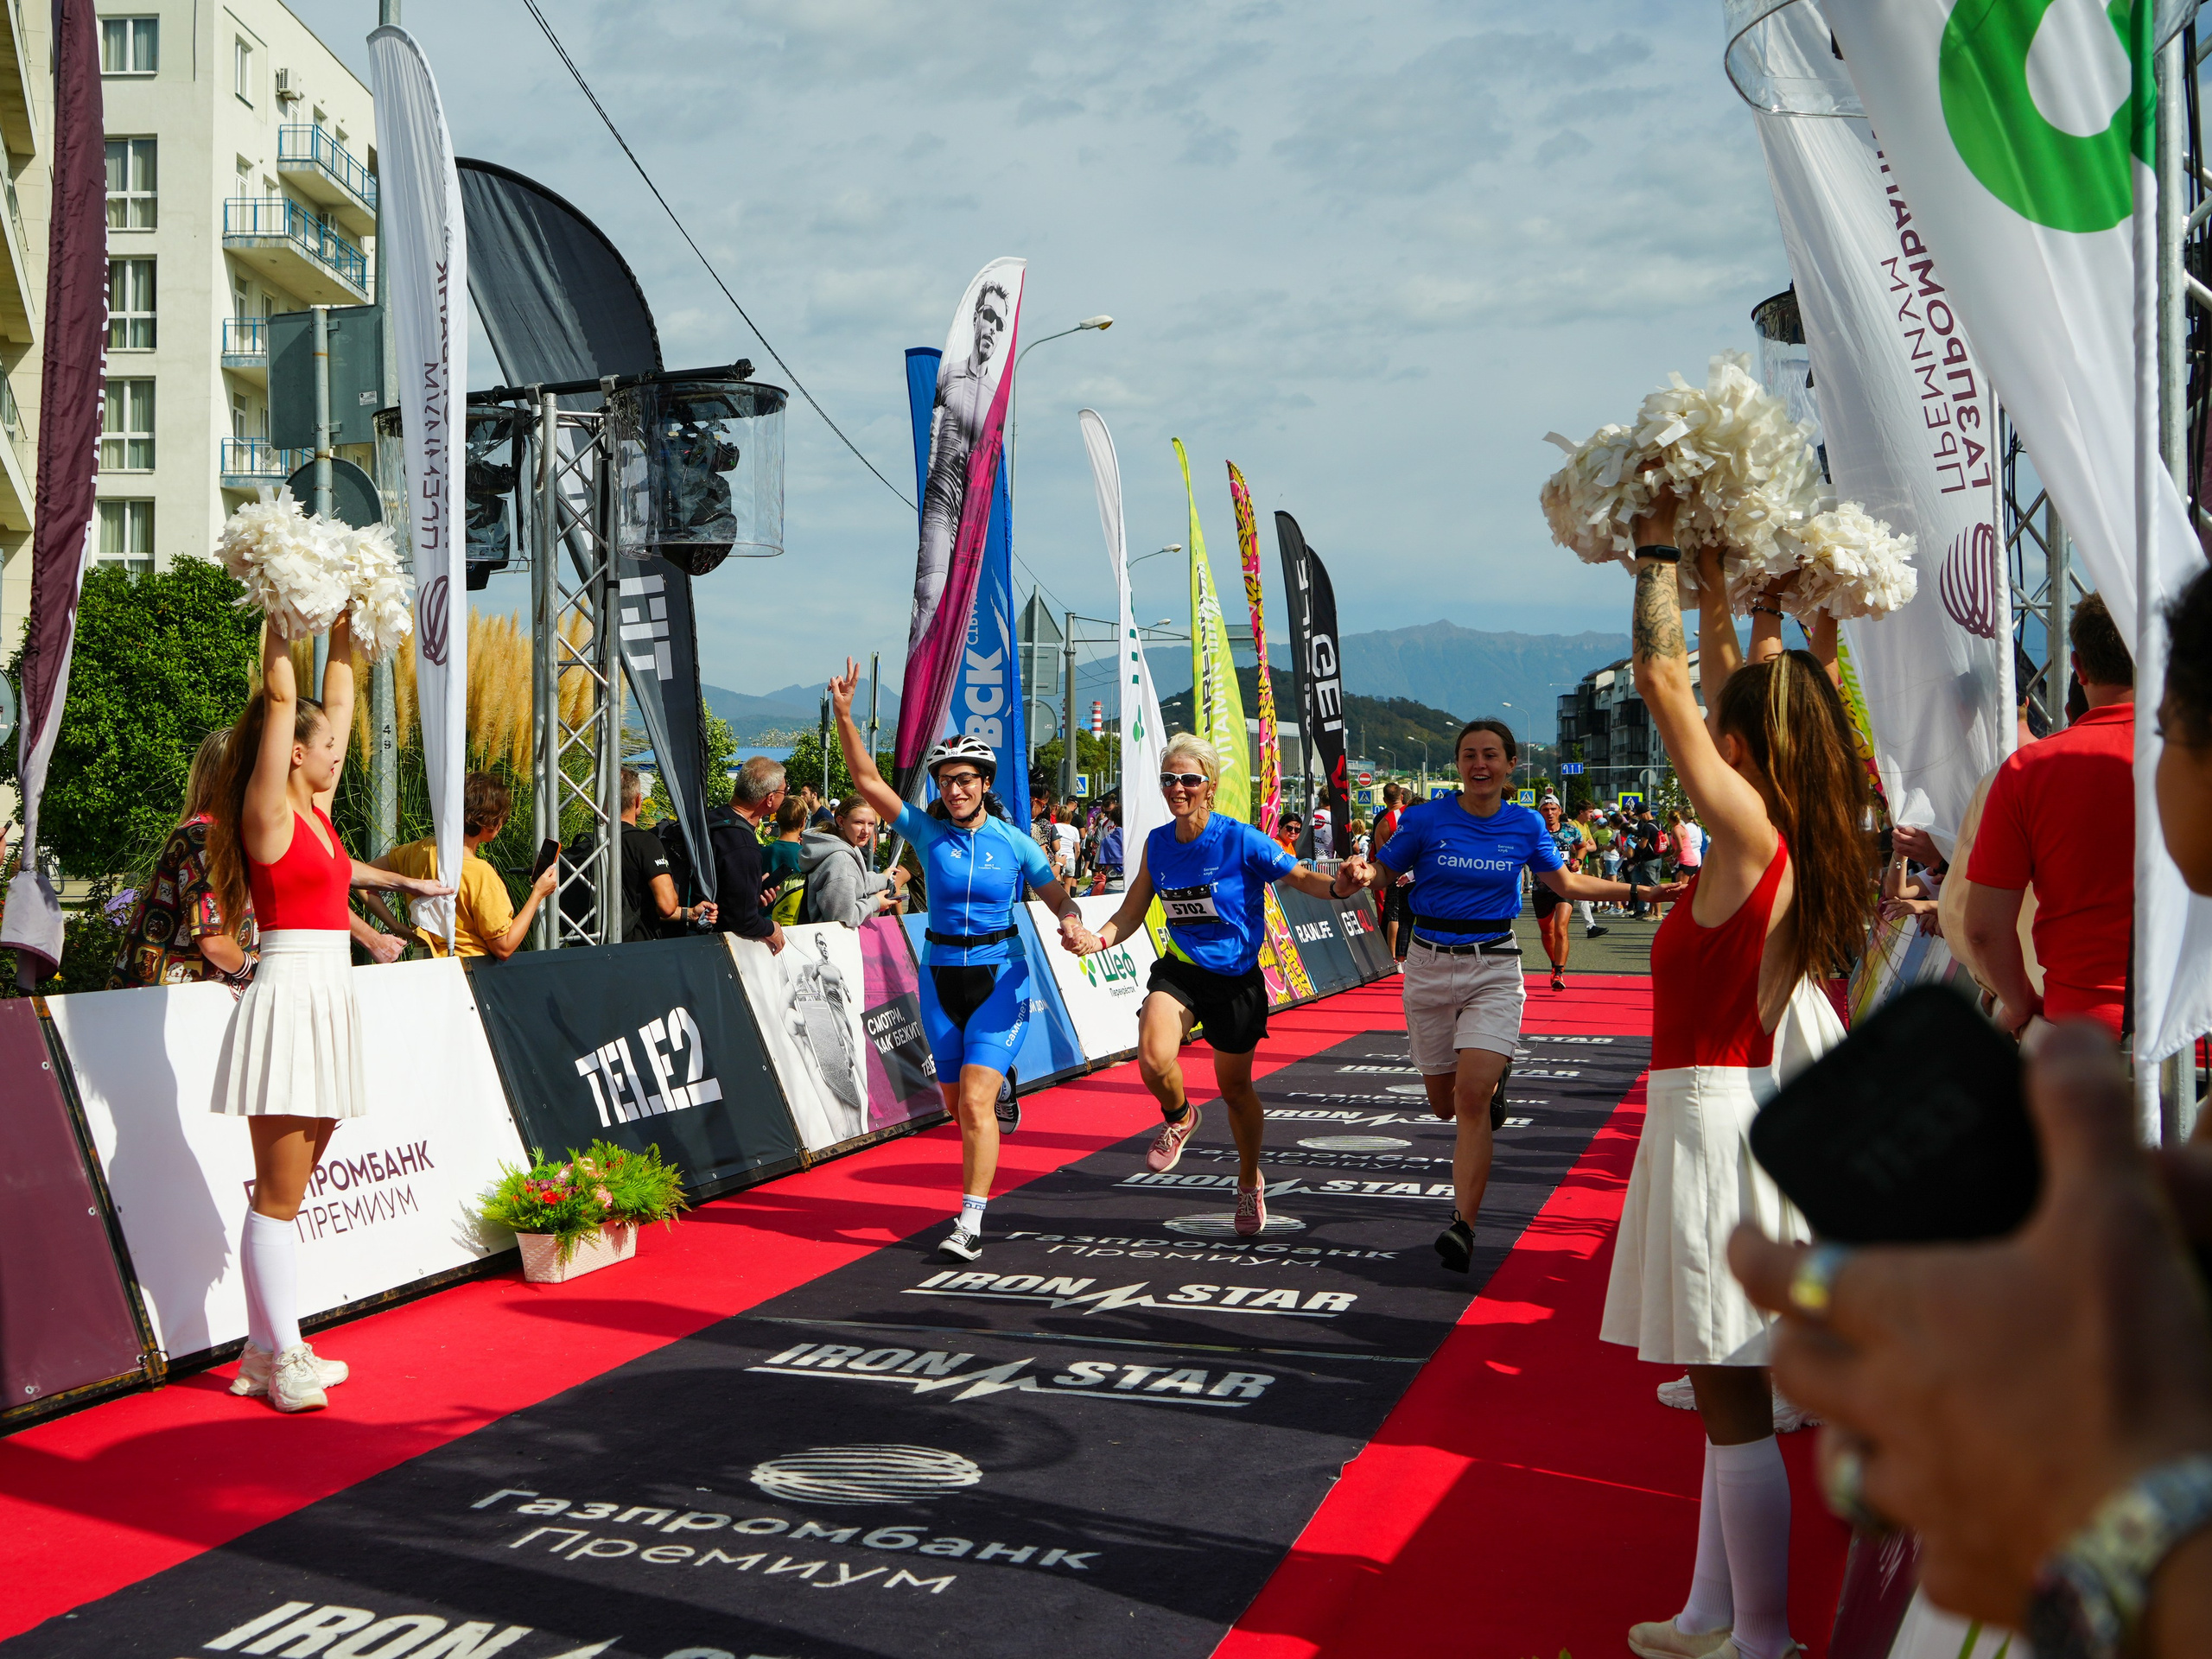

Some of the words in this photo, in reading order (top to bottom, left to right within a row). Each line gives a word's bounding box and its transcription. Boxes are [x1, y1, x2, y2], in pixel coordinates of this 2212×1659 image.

[1210, 662, 1236, 772] VITAMIN
[1437, 855, 1514, 872] самолет
[1172, 903, 1207, 915] 5702
[1341, 909, 1375, 937] GEL4U
[1095, 943, 1139, 987] Шеф
[868, 1007, 898, 1036] СМОТРИ,
[874, 1033, 894, 1055] КАК
[893, 1021, 921, 1047] БЕЖИТ
[1005, 1000, 1028, 1047] самолет
[574, 1007, 723, 1128] TELE2
[243, 1140, 435, 1206] ГПРОМБАНК
[295, 1183, 419, 1243] ПРЕМИУМ
[1005, 1230, 1401, 1260] Газпромбанк
[1046, 1244, 1322, 1268] Премиум
[917, 1270, 1096, 1294] IRON
[1166, 1283, 1358, 1312] STAR
[766, 1343, 976, 1376] IRON
[1052, 1361, 1276, 1399] STAR
[470, 1488, 1104, 1569] Газпромбанк
[508, 1526, 959, 1594] Премиум
[202, 1600, 534, 1659] IRON
